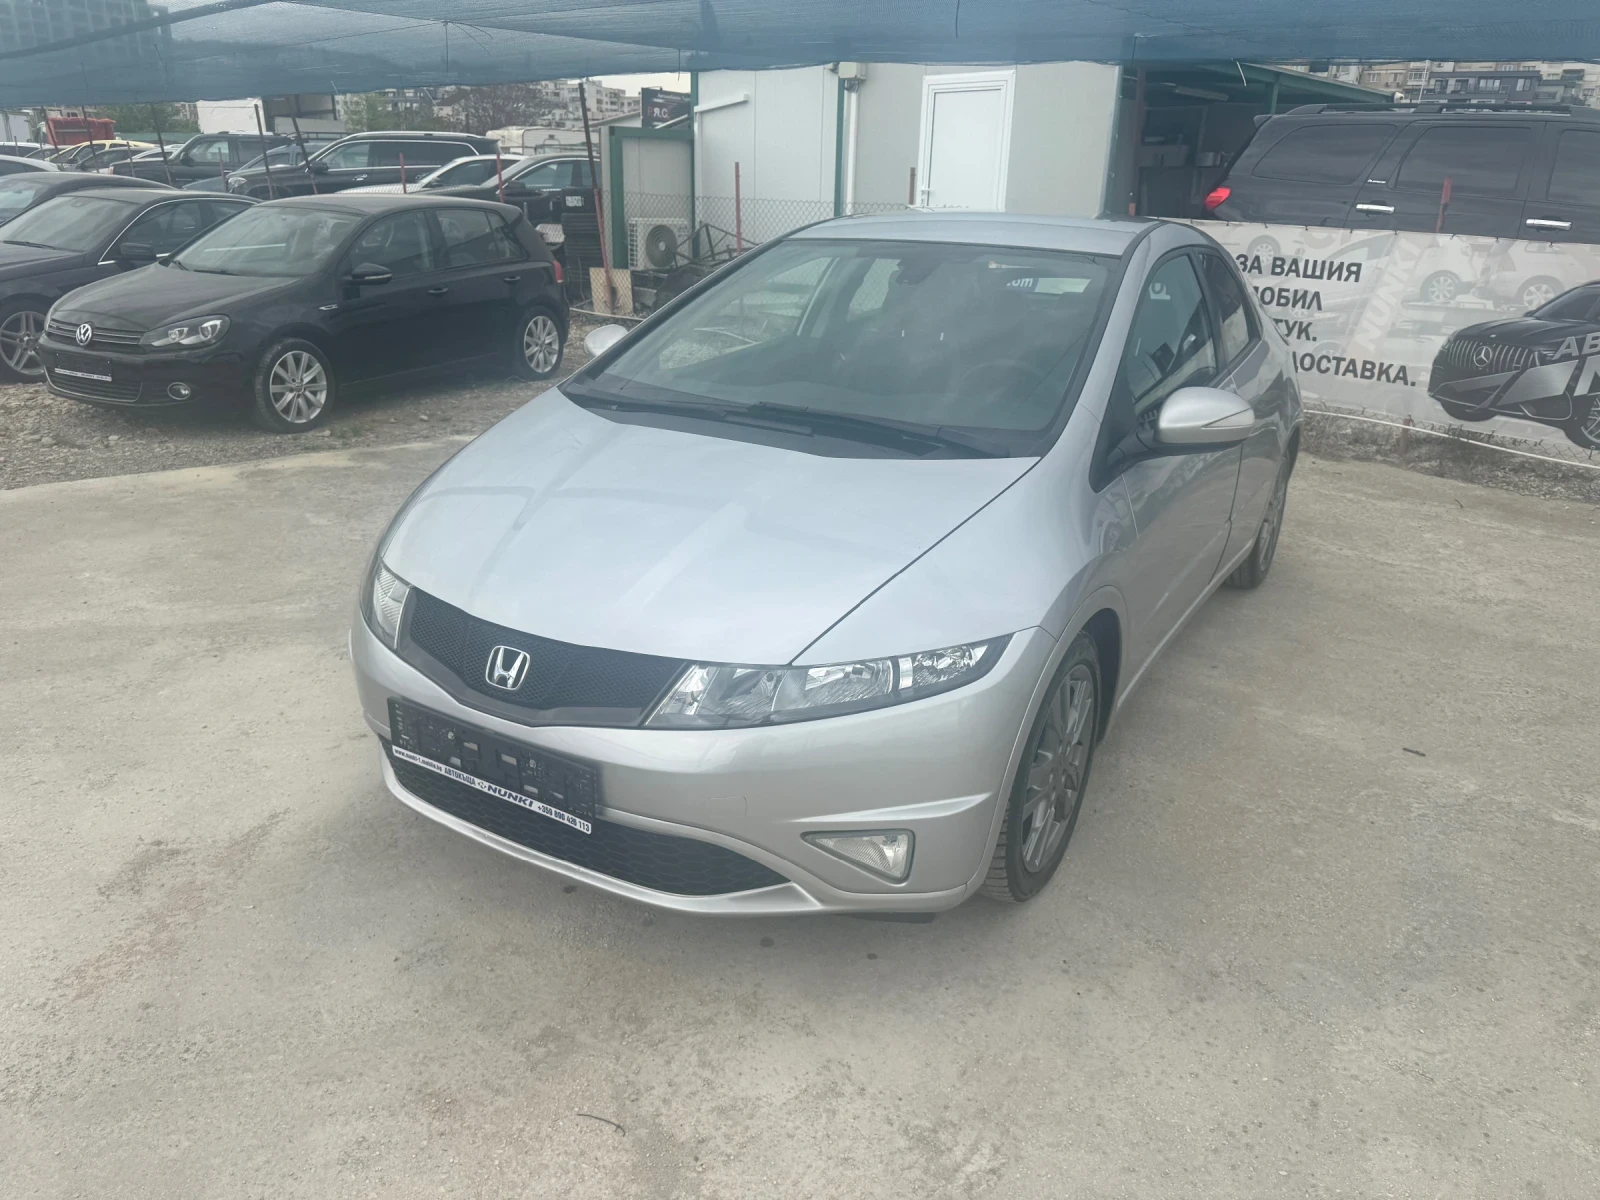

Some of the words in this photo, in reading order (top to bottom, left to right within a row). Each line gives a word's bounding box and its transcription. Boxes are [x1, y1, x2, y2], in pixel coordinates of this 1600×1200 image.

[1236, 254, 1262, 274] ЗА
[1271, 256, 1362, 282] ВАШИЯ
[1253, 286, 1322, 311] ОБИЛ
[1292, 351, 1416, 387] ОСТАВКА.
[487, 784, 534, 807] NUNKI
[537, 805, 553, 816] +359
[578, 820, 590, 832] 113
